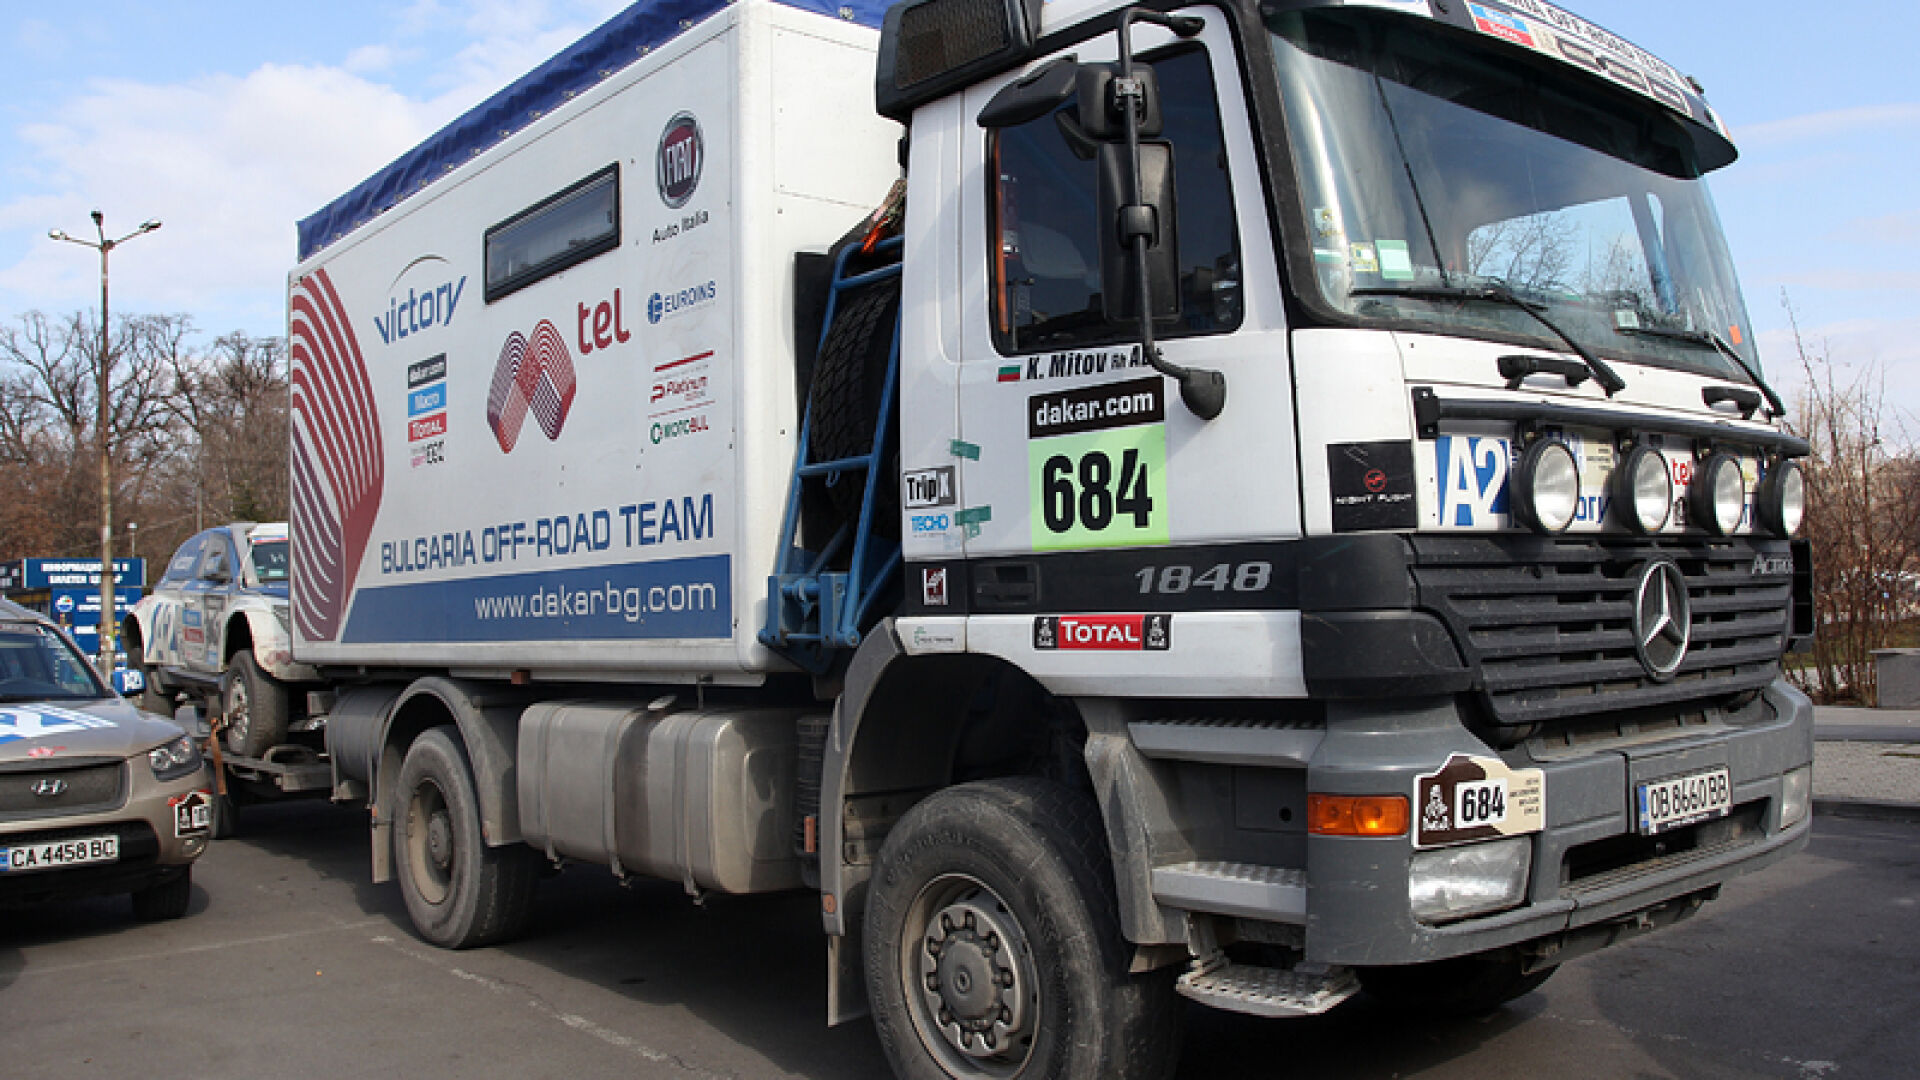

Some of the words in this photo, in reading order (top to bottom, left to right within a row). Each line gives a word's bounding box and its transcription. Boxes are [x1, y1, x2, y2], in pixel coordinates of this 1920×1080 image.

[667, 137, 691, 185] FIAT
[653, 224, 680, 243] Auto
[373, 275, 467, 345] victory
[665, 280, 716, 312] EUROINS
[578, 288, 632, 354] tel
[1027, 356, 1045, 380] K.
[1049, 352, 1108, 377] Mitov
[1036, 392, 1154, 426] dakar.com
[1043, 448, 1153, 533] 684
[381, 528, 477, 575] BULGARIA
[482, 508, 611, 563] OFF-ROAD
[619, 493, 714, 547] TEAM
[1135, 561, 1273, 594] 1848
[475, 579, 717, 623] www.dakarbg.com
[1462, 784, 1505, 822] 684
[1709, 774, 1728, 806] BB
[11, 848, 37, 868] CA
[41, 842, 88, 865] 4458
[90, 839, 115, 859] BC
